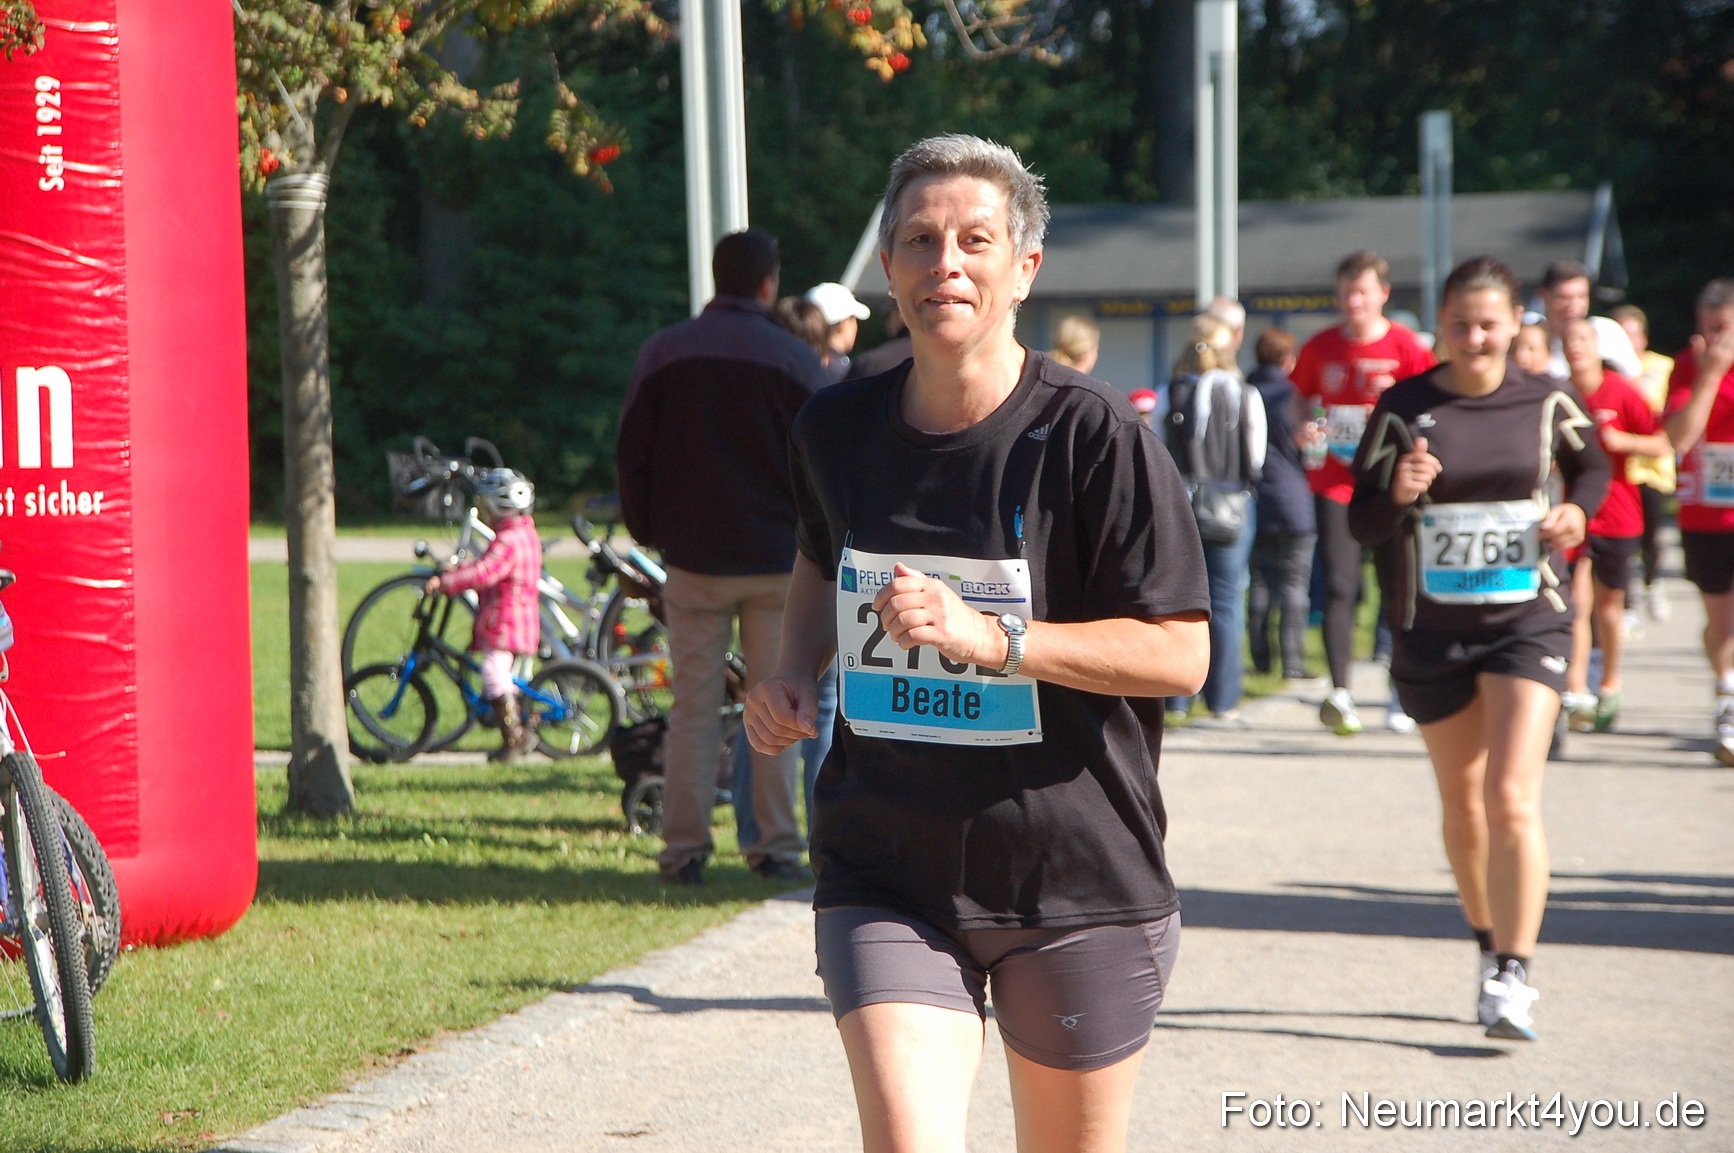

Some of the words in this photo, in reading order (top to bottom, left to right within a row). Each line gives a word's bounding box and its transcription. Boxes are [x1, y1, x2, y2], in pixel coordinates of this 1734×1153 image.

[35, 75, 62, 136] 1929
[39, 144, 65, 191] Seit
[0, 366, 73, 469] n
[0, 487, 15, 517] t
[25, 480, 104, 517] sicher
[1435, 531, 1524, 566] 2765
[961, 581, 1011, 596] BOCK
[892, 677, 981, 720] Beate
